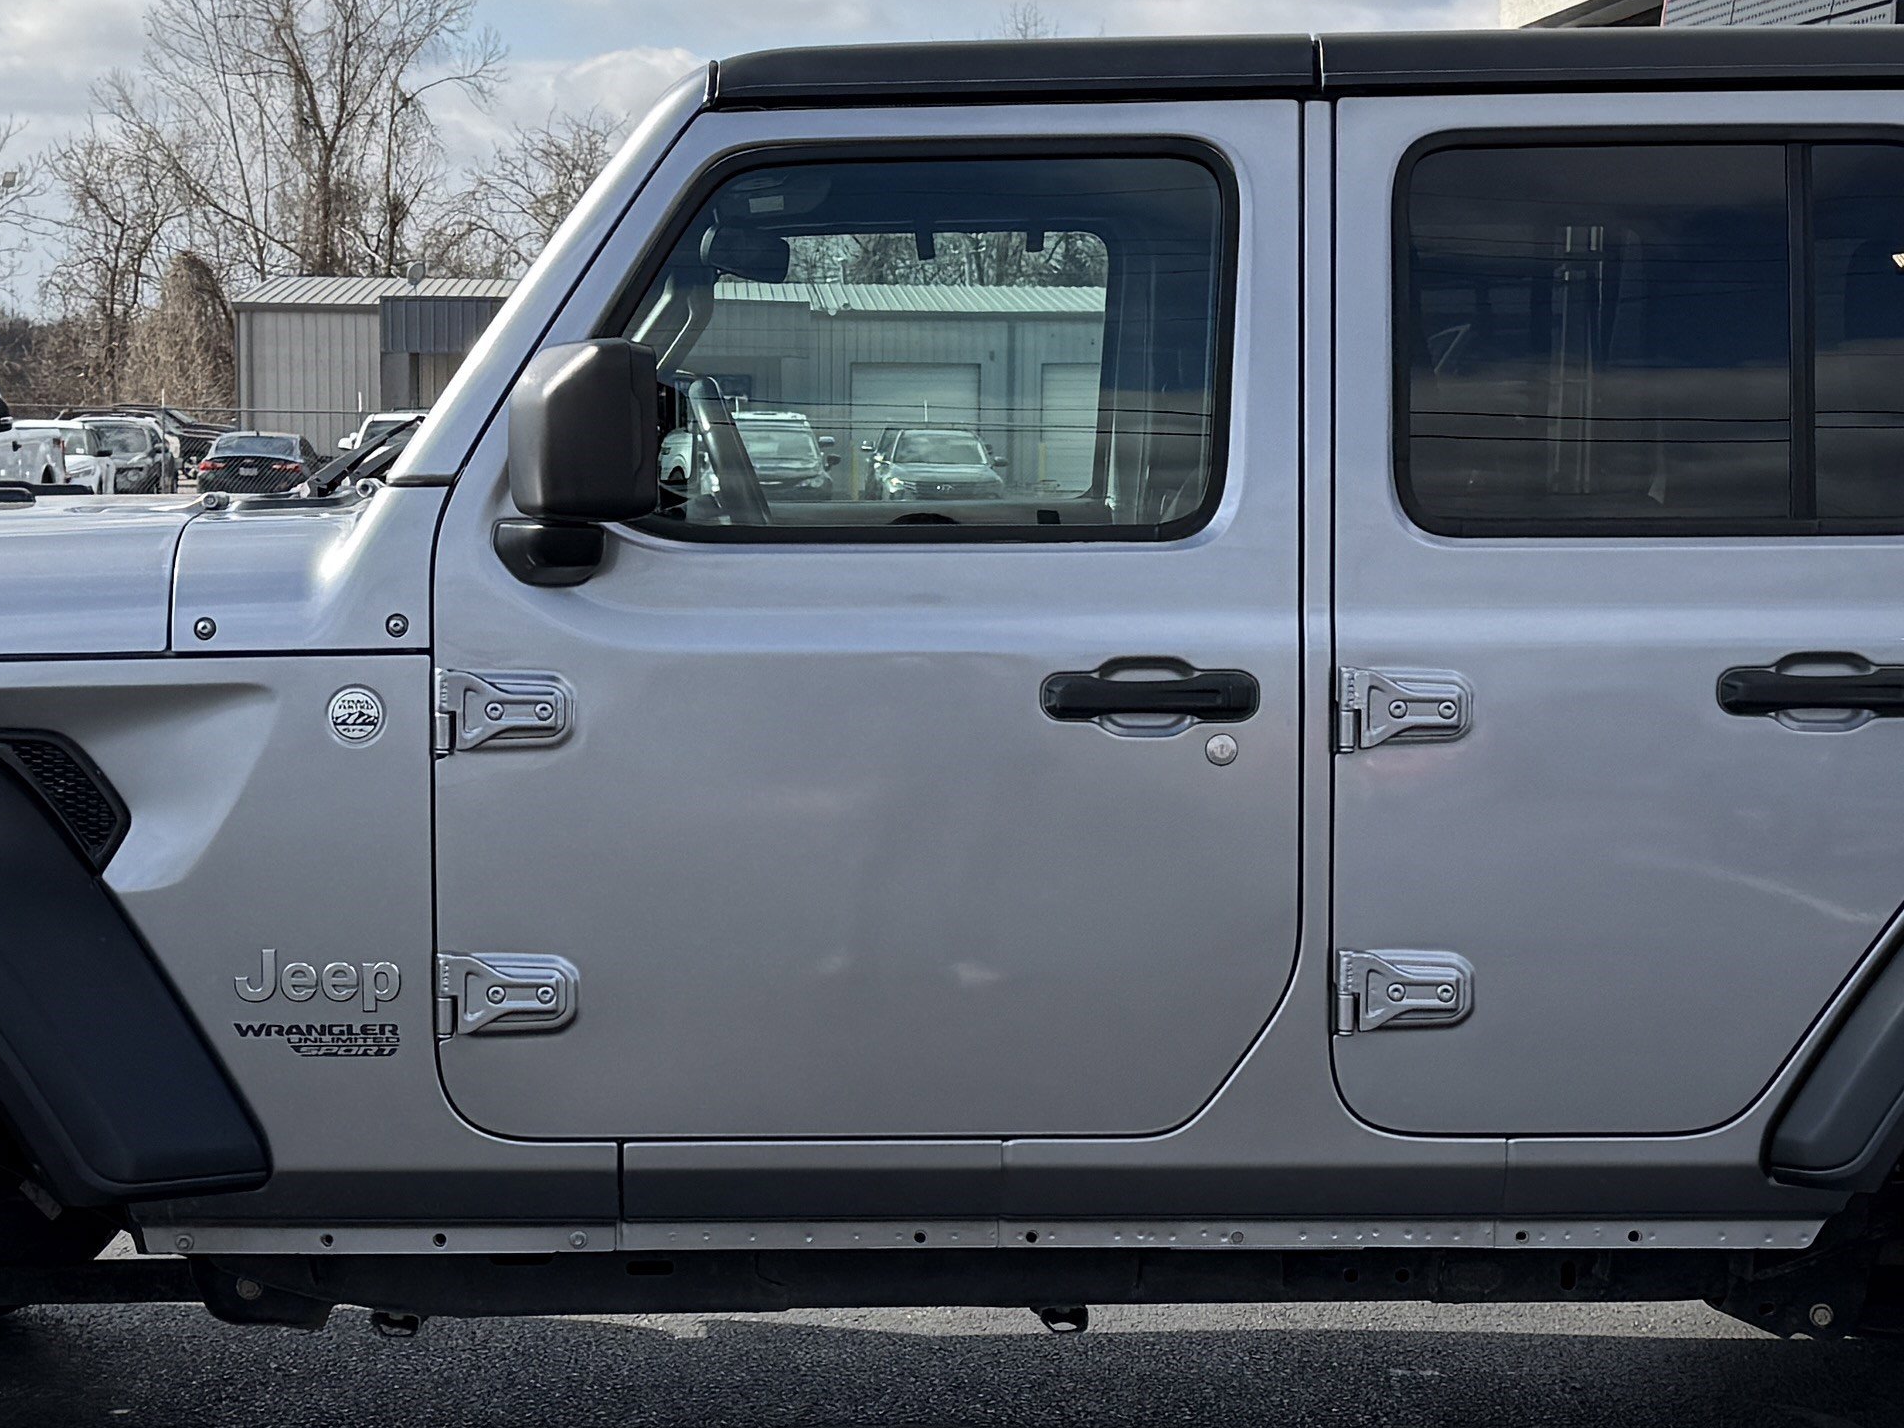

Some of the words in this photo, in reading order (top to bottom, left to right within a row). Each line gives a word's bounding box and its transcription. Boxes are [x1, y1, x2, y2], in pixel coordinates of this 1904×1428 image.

[234, 948, 402, 1013] Jeep
[233, 1022, 399, 1037] WRANGLER
[287, 1036, 400, 1045] UNLIMITED
[298, 1045, 397, 1056] SPORT
